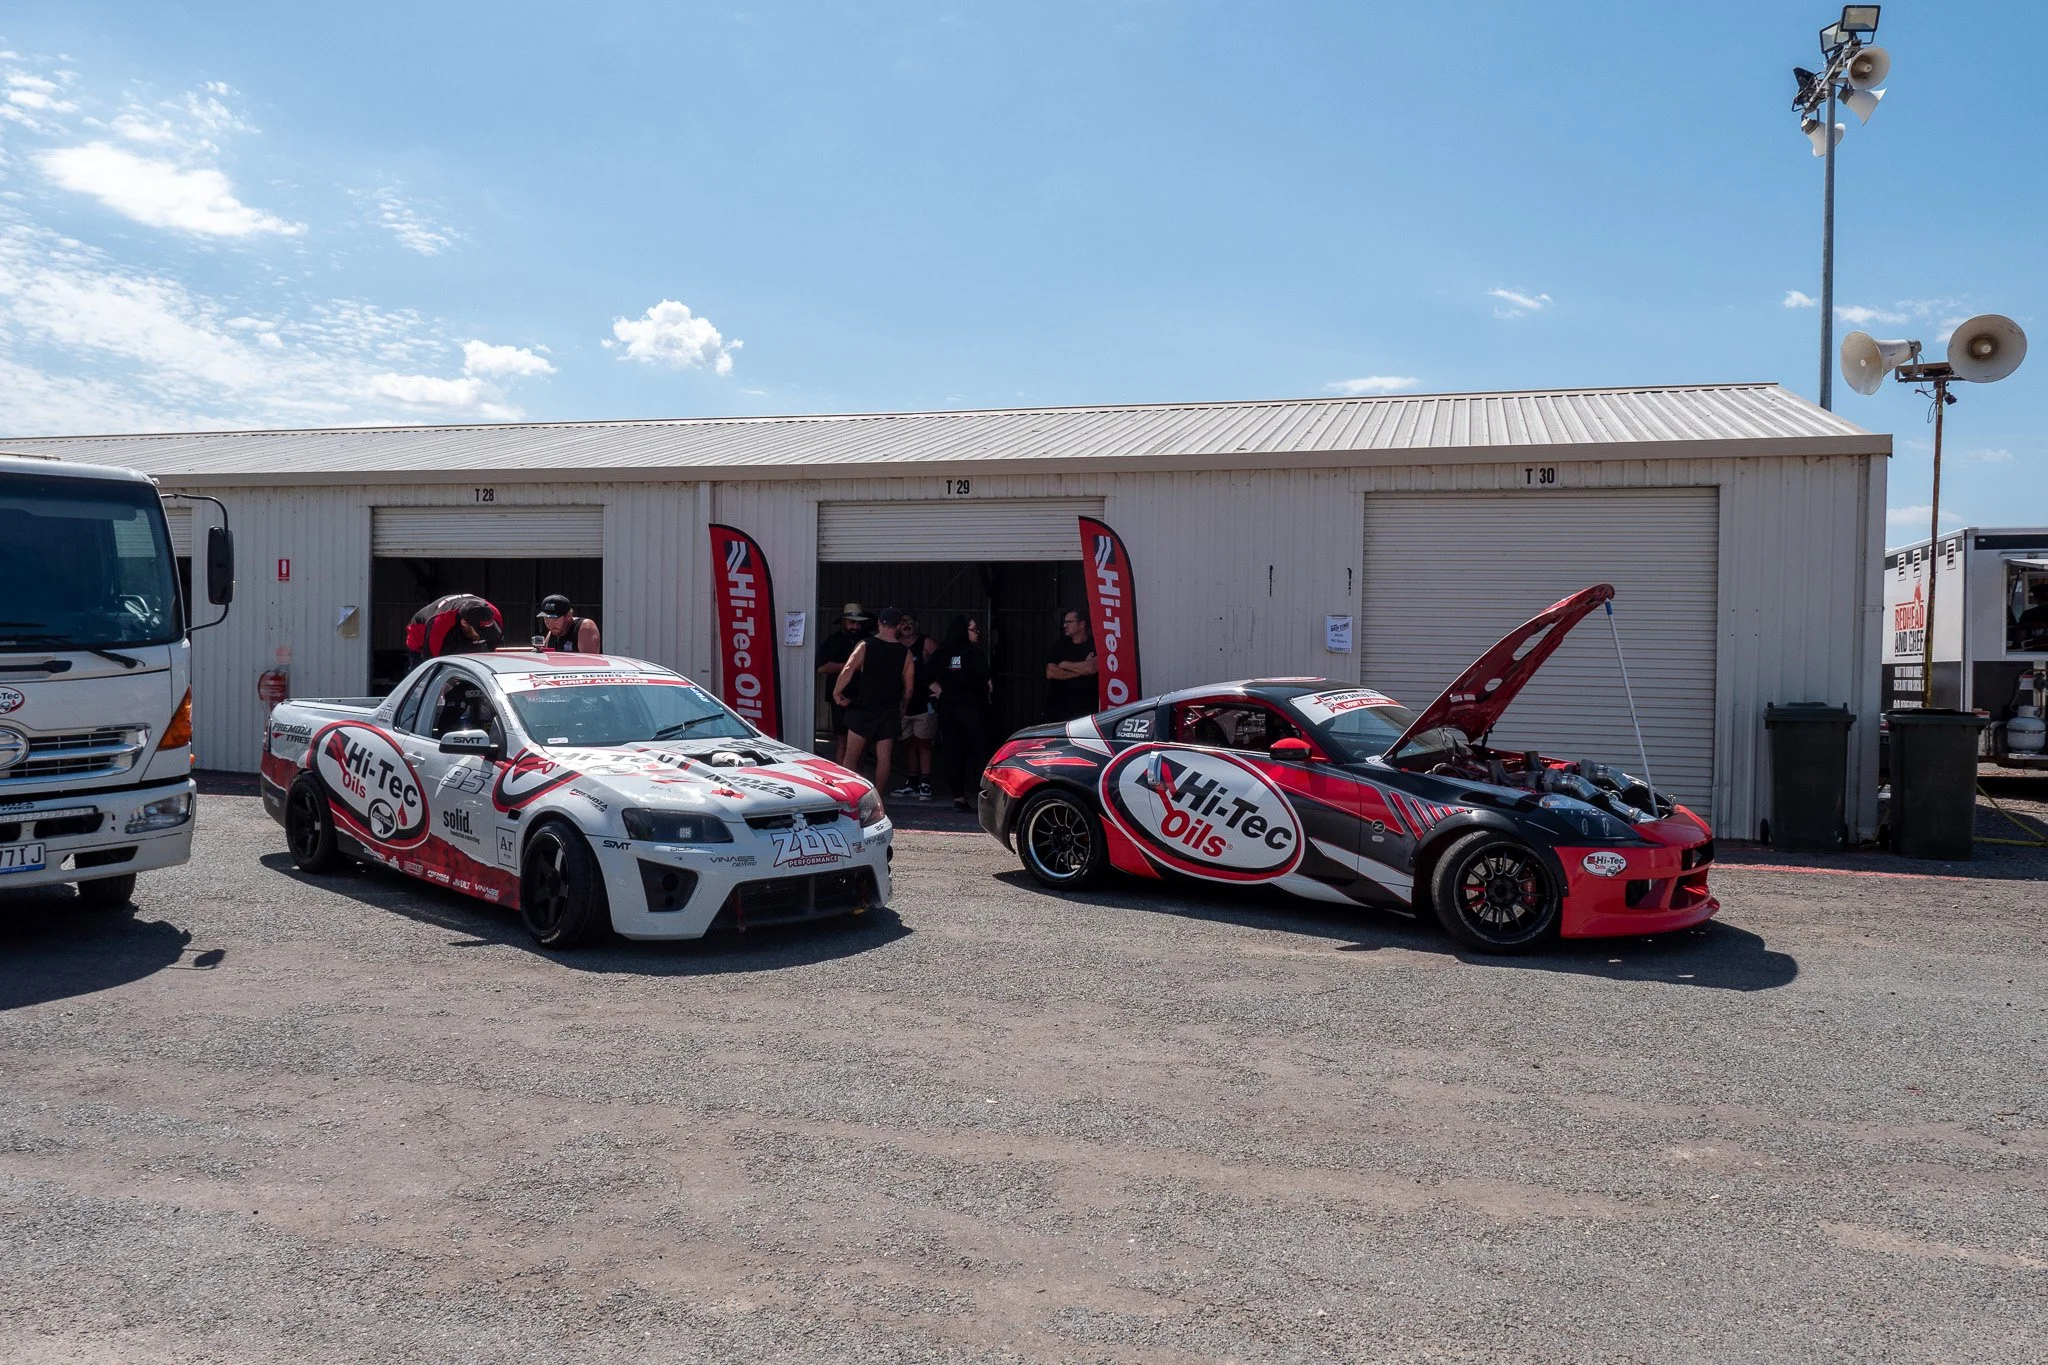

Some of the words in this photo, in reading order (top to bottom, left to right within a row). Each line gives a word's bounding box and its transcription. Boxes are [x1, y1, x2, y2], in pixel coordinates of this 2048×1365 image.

[1525, 468, 1533, 484] T
[1539, 467, 1555, 484] 30
[475, 488, 480, 502] T
[482, 488, 494, 502] 28
[946, 480, 952, 495] T
[956, 479, 970, 495] 29
[728, 572, 756, 669] Hi-Tec
[1096, 569, 1122, 673] Hi-Tec
[1894, 604, 1924, 631] REDHEAD
[1894, 632, 1908, 653] AND
[1908, 630, 1924, 652] CHEF
[272, 722, 312, 736] PREMOZA
[1122, 718, 1150, 733] 512
[285, 734, 311, 745] TYRES
[453, 736, 483, 745] SMT
[346, 740, 419, 809] Hi-Tec
[441, 764, 493, 795] 95
[342, 771, 366, 799] Oils
[570, 788, 609, 810] PREMOZA
[1170, 770, 1293, 850] Hi-Tec
[443, 808, 473, 835] solid.
[500, 836, 514, 852] Ar
[602, 839, 632, 851] SMT
[770, 826, 852, 867] ZOO
[709, 855, 756, 864] VINAGE
[788, 854, 839, 867] PERFORMANCE
[1596, 855, 1625, 865] Hi-Tec
